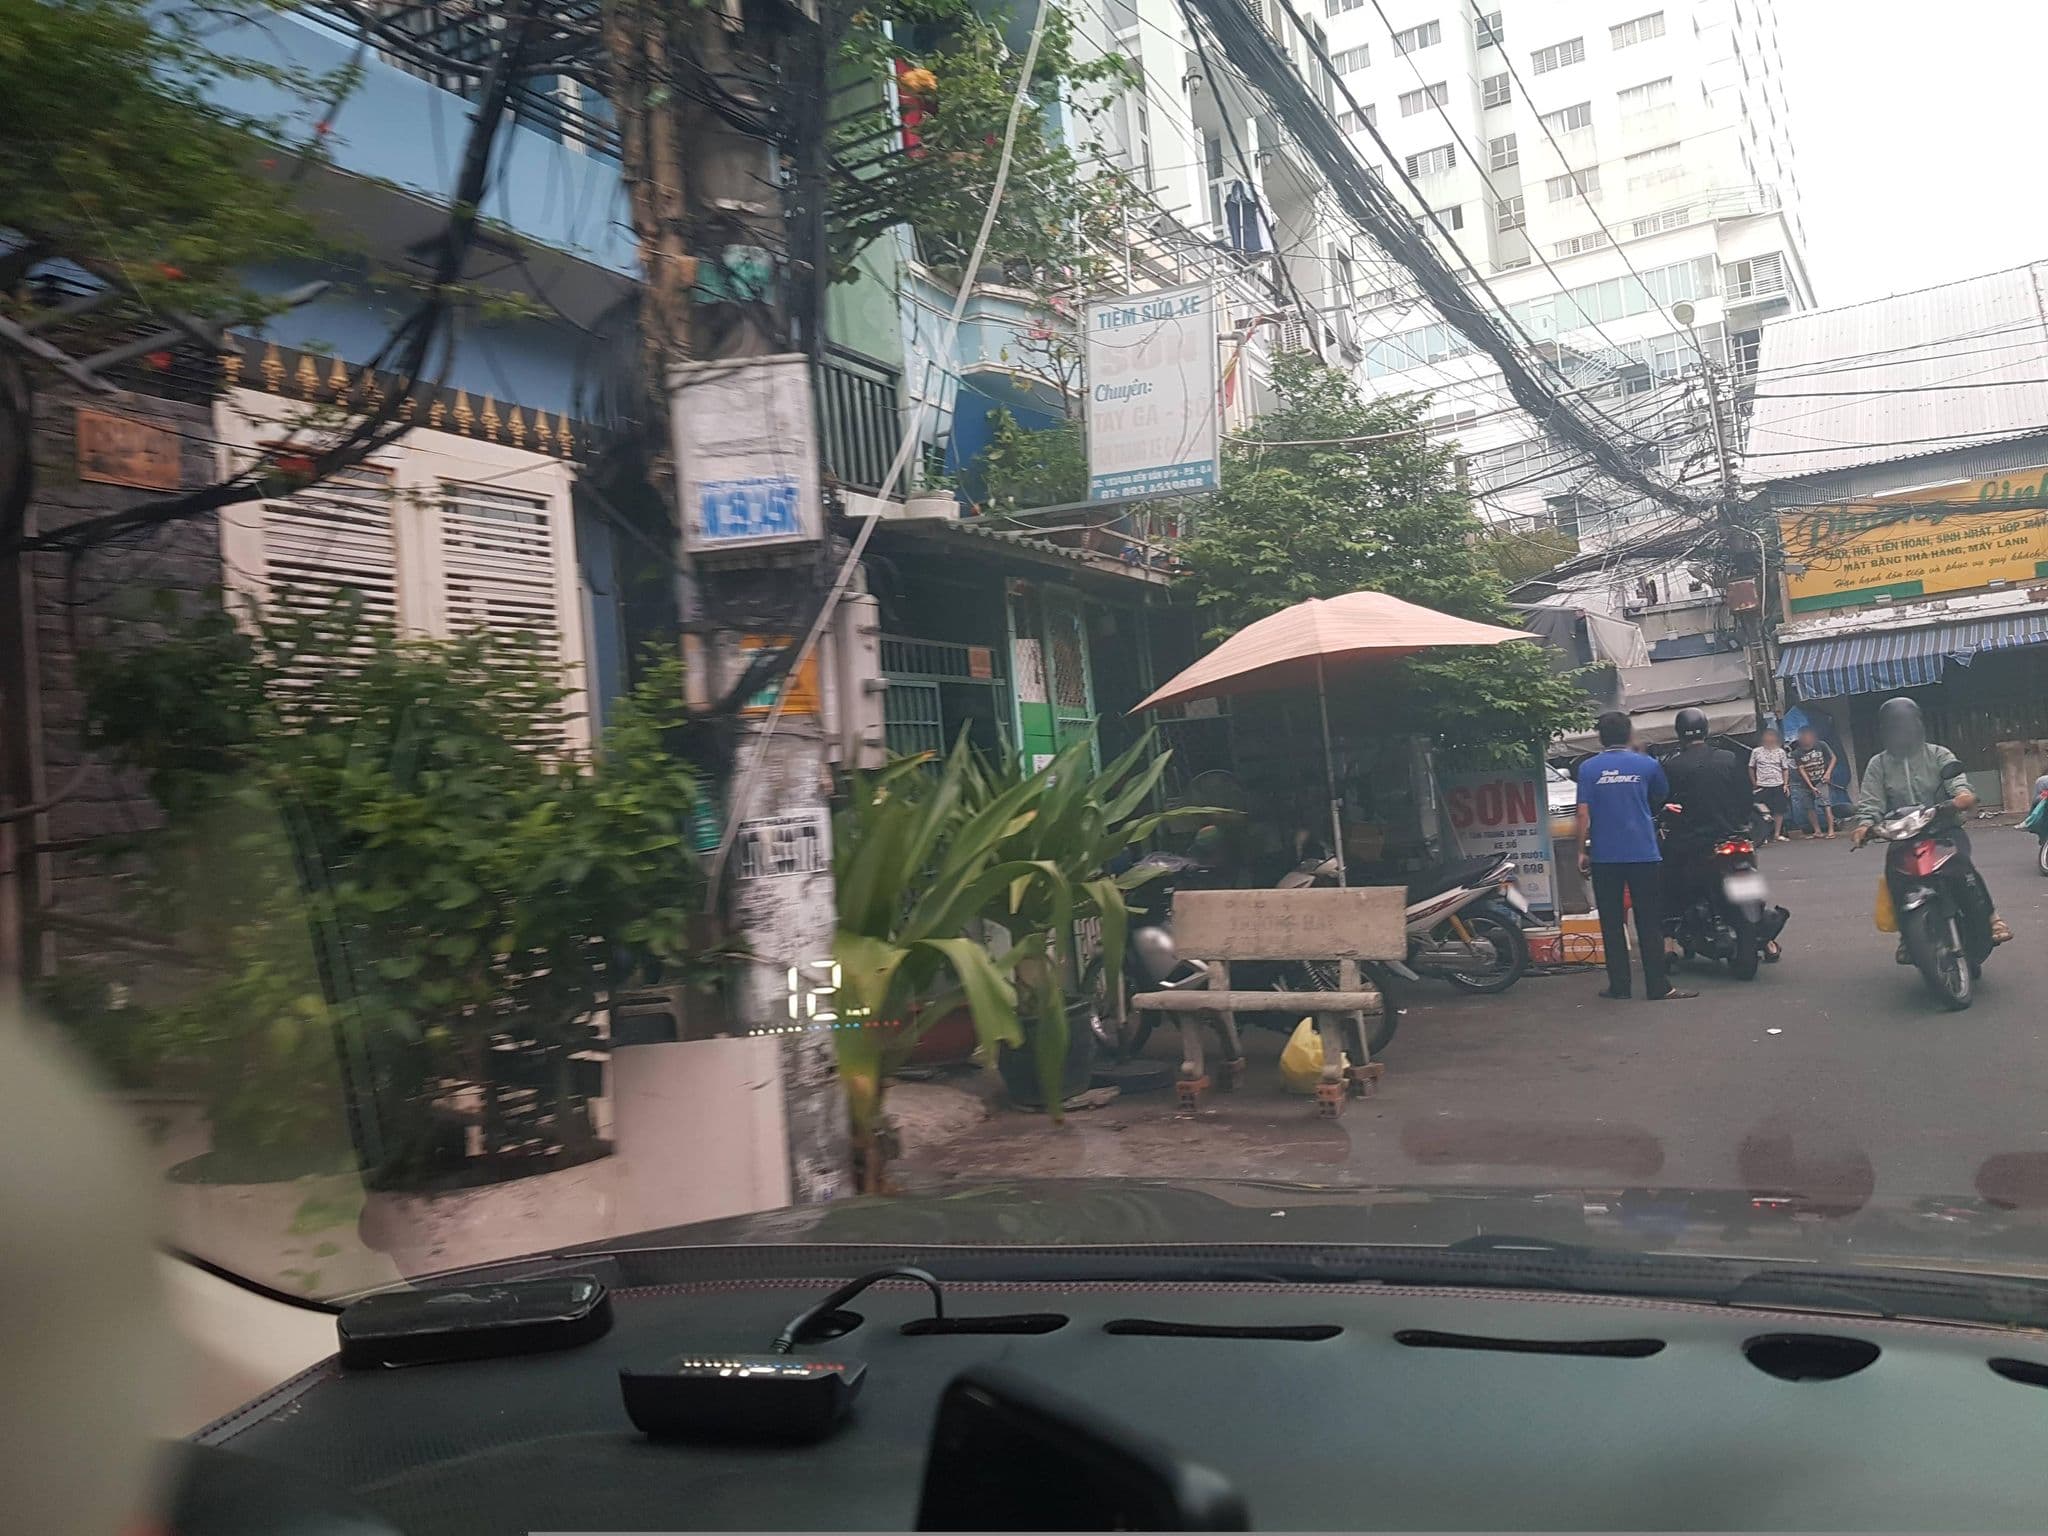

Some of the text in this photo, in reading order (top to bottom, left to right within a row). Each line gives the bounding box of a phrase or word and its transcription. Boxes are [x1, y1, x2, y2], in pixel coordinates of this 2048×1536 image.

[1098, 295, 1201, 332] TIỆM SỬA XE
[1997, 536, 2029, 550] LẠNH
[1596, 774, 1641, 785] ADVANCE
[1449, 779, 1538, 828] SƠN
[788, 960, 842, 1022] 12
